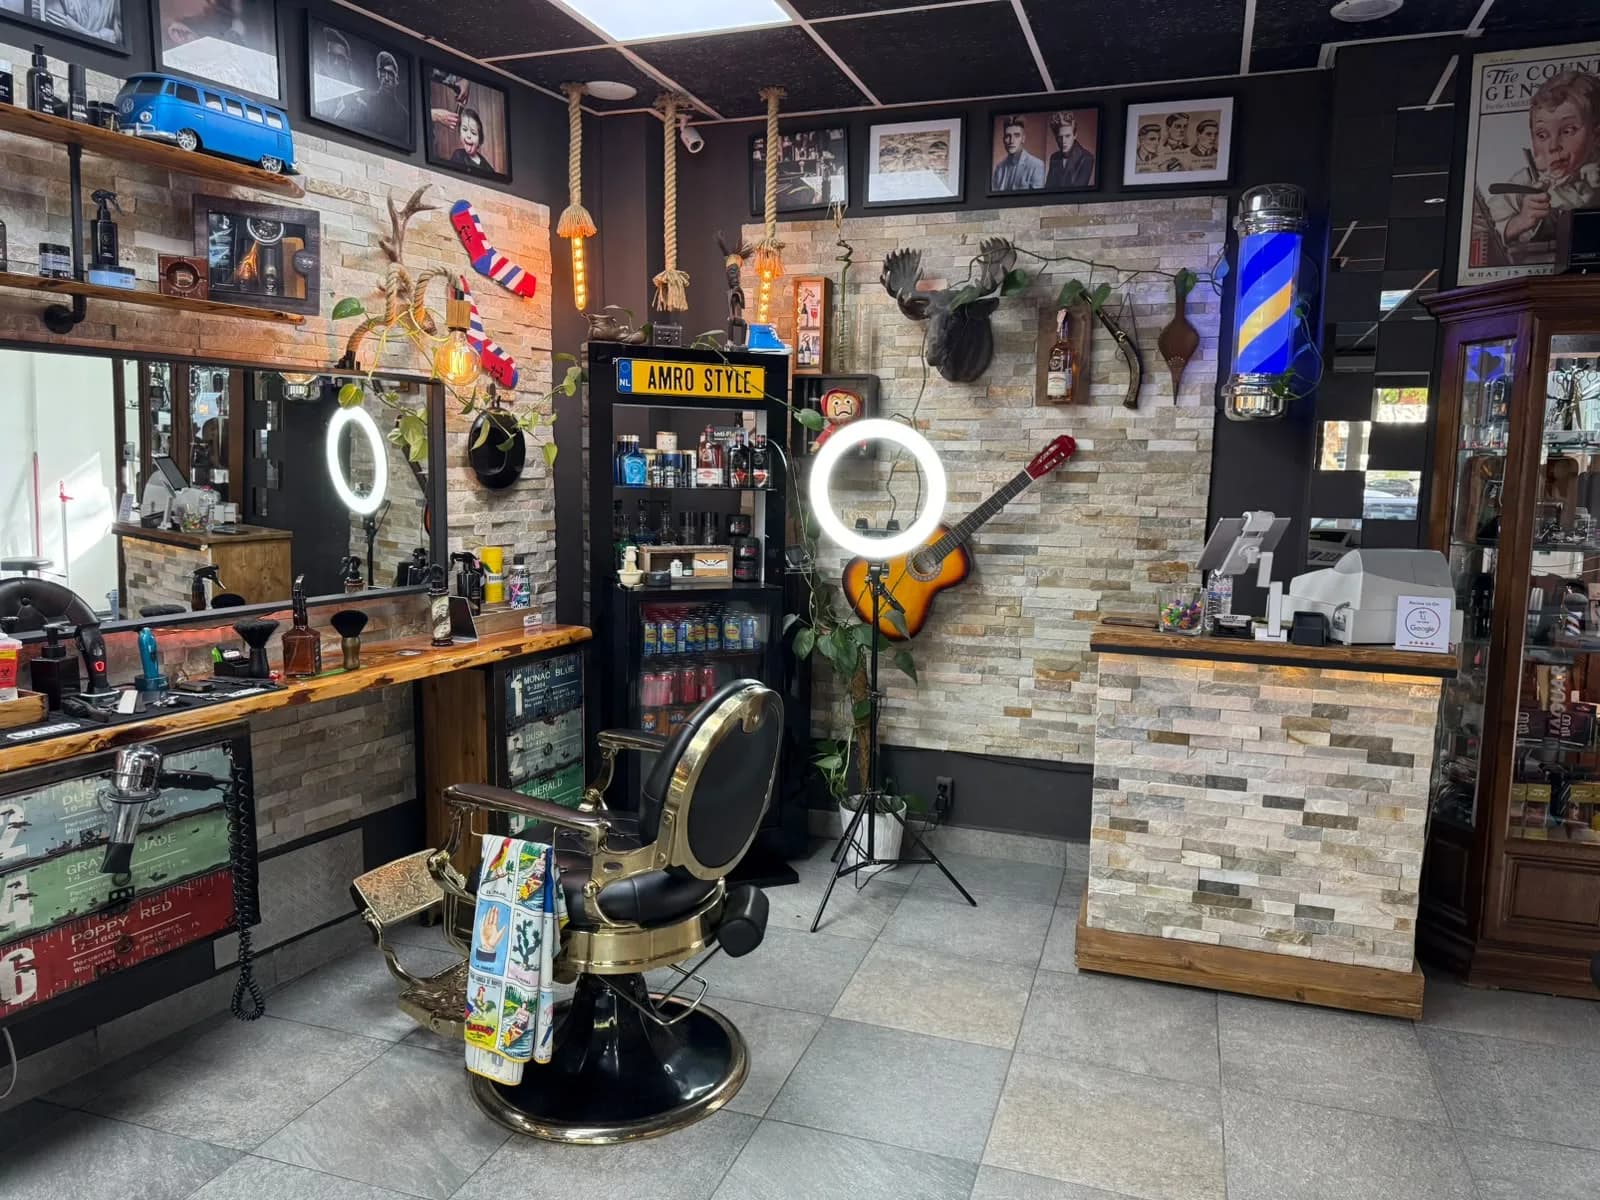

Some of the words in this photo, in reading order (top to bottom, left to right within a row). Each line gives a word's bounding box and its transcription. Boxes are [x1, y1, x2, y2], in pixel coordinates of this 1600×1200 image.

[1487, 66, 1520, 85] The
[1485, 83, 1540, 101] GEN
[619, 378, 631, 388] NL
[648, 365, 694, 391] AMRO
[704, 368, 752, 394] STYLE
[510, 673, 523, 717] 1
[62, 789, 97, 807] DUS
[139, 832, 177, 852] JADE
[140, 901, 173, 920] RED
[71, 916, 129, 946] POPPY
[0, 946, 38, 1005] 6
